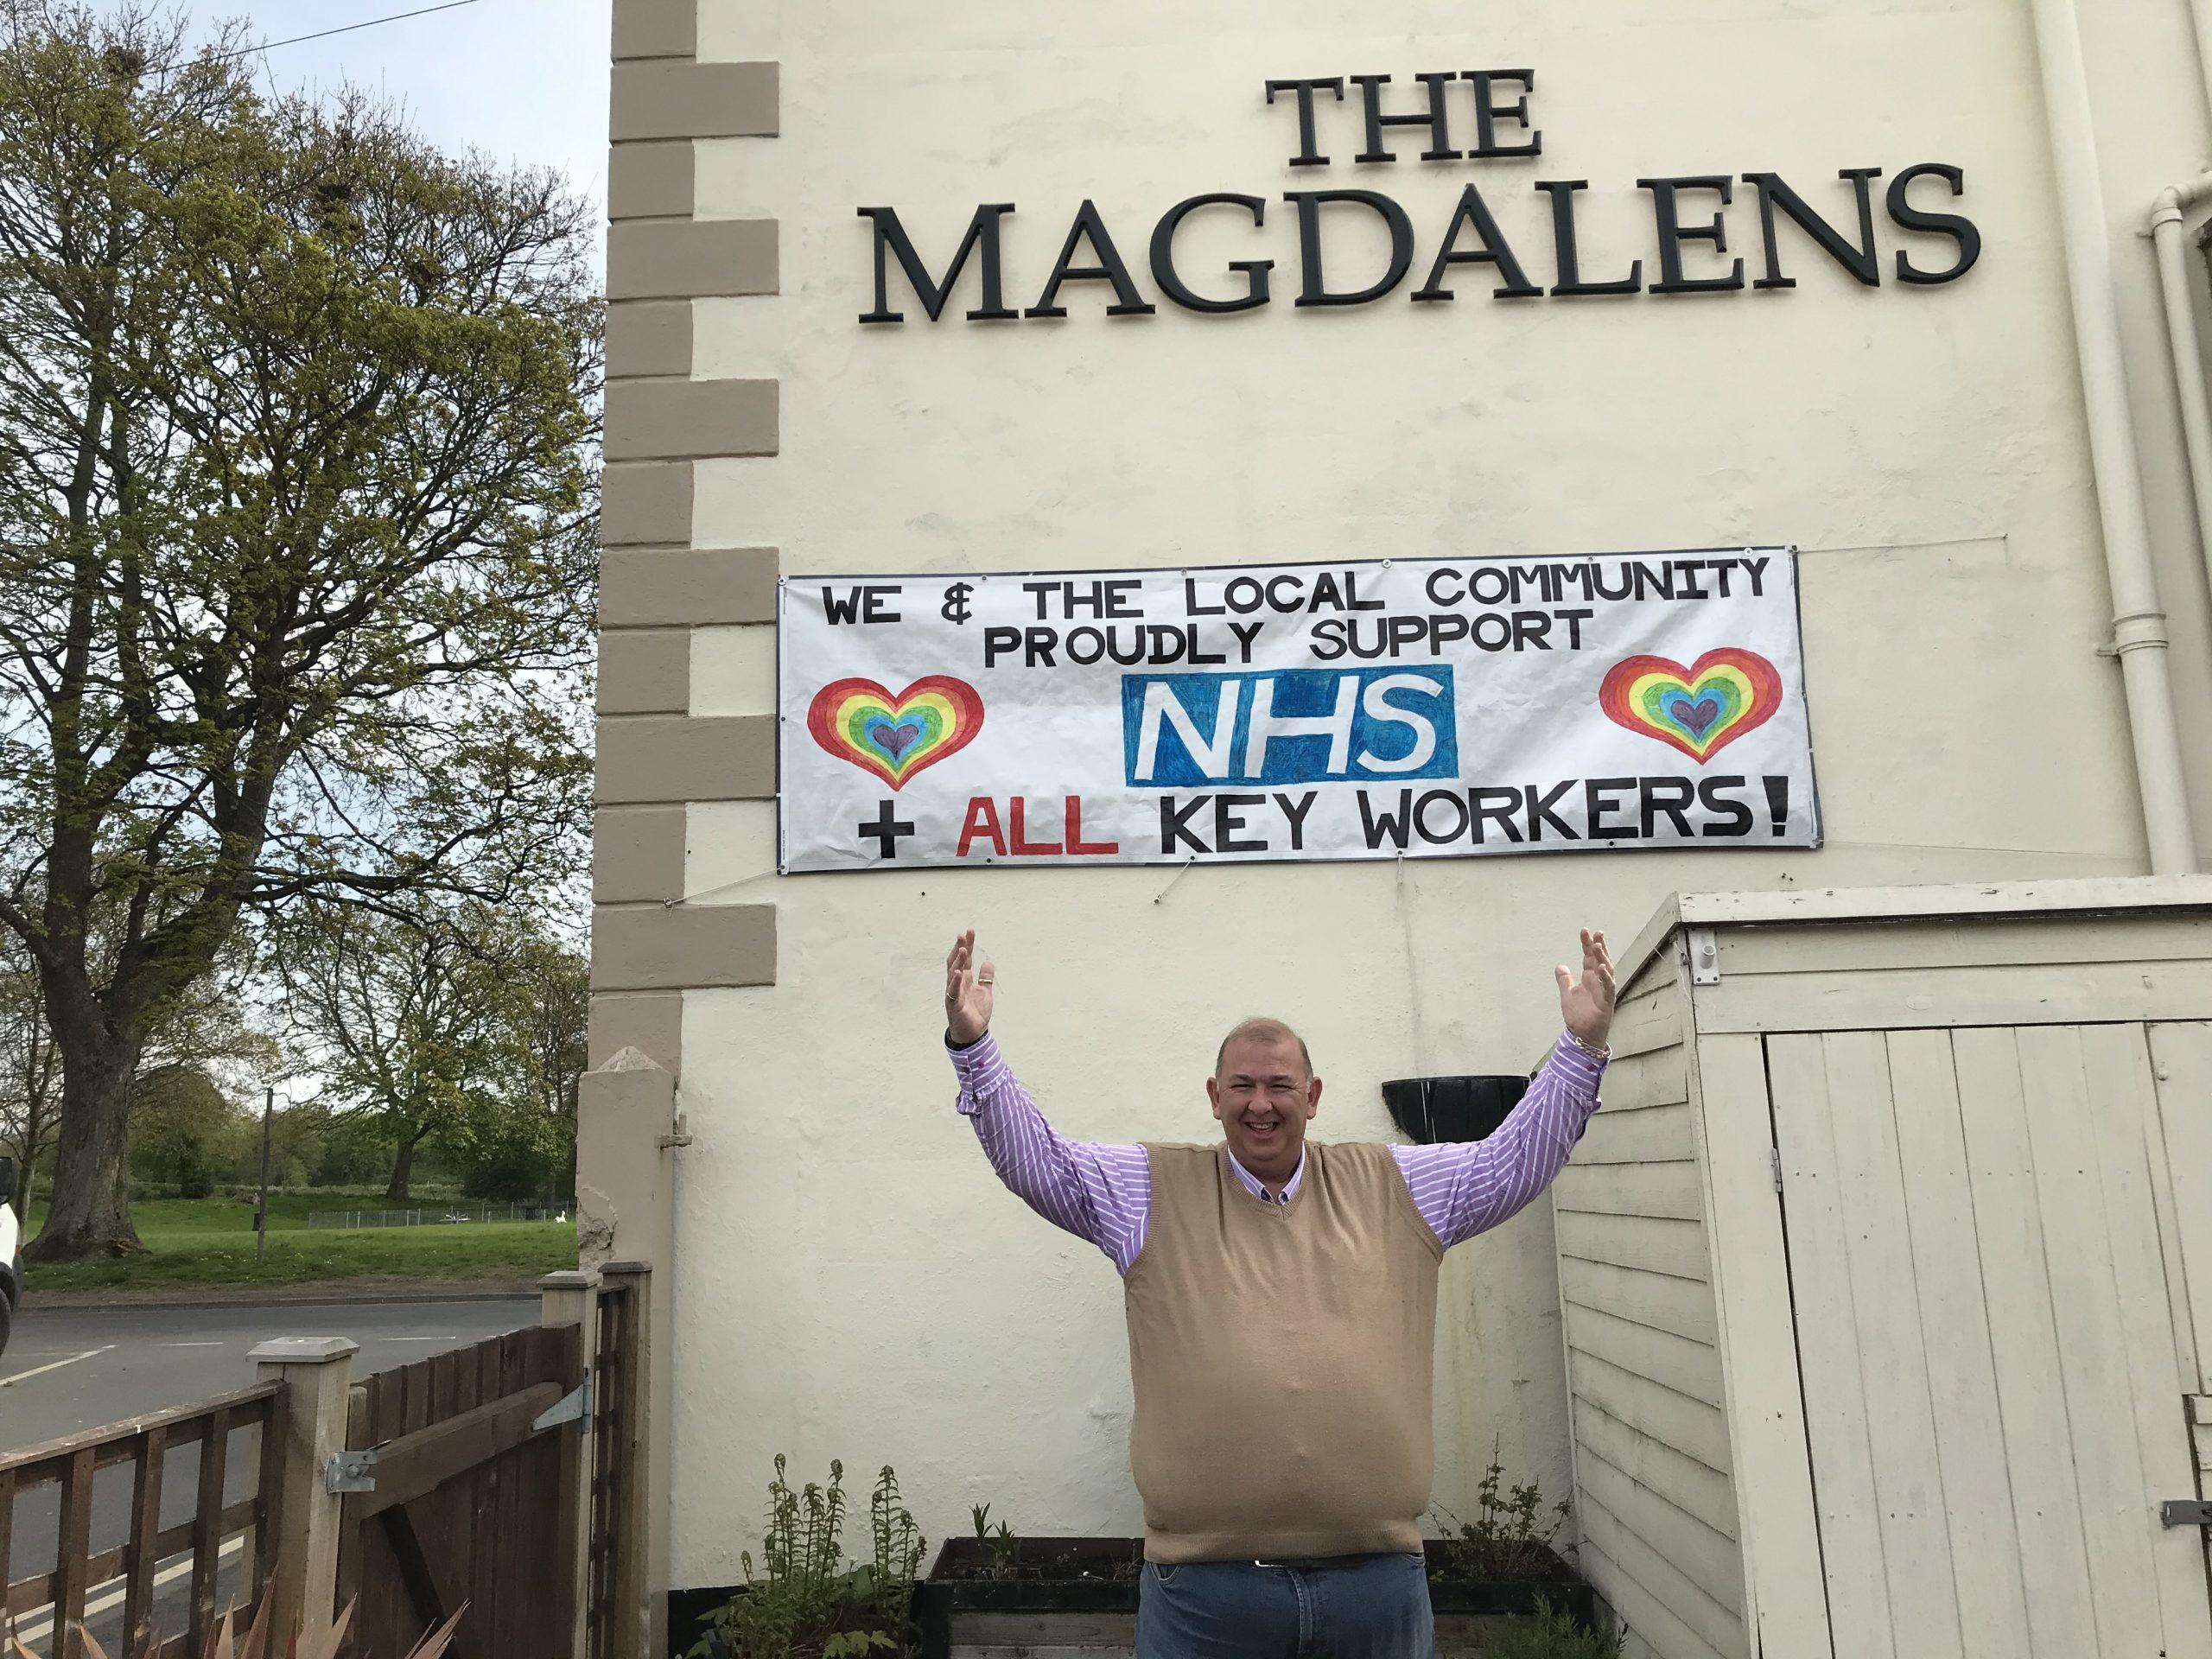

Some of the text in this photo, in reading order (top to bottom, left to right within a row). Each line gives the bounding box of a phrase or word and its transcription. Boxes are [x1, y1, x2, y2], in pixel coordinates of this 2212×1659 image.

[1266, 68, 1543, 167] THE
[857, 162, 1982, 324] MAGDALENS
[822, 585, 902, 626] WE
[1023, 579, 1144, 620] THE
[1185, 572, 1385, 614] LOCAL
[1425, 556, 1770, 607] COMMUNITY
[984, 608, 1594, 669] PROUDLY SUPPORT
[1134, 672, 1445, 780] NHS
[956, 795, 1119, 857] ALL
[1159, 791, 1318, 854] KEY
[1357, 775, 1789, 850] WORKERS!
